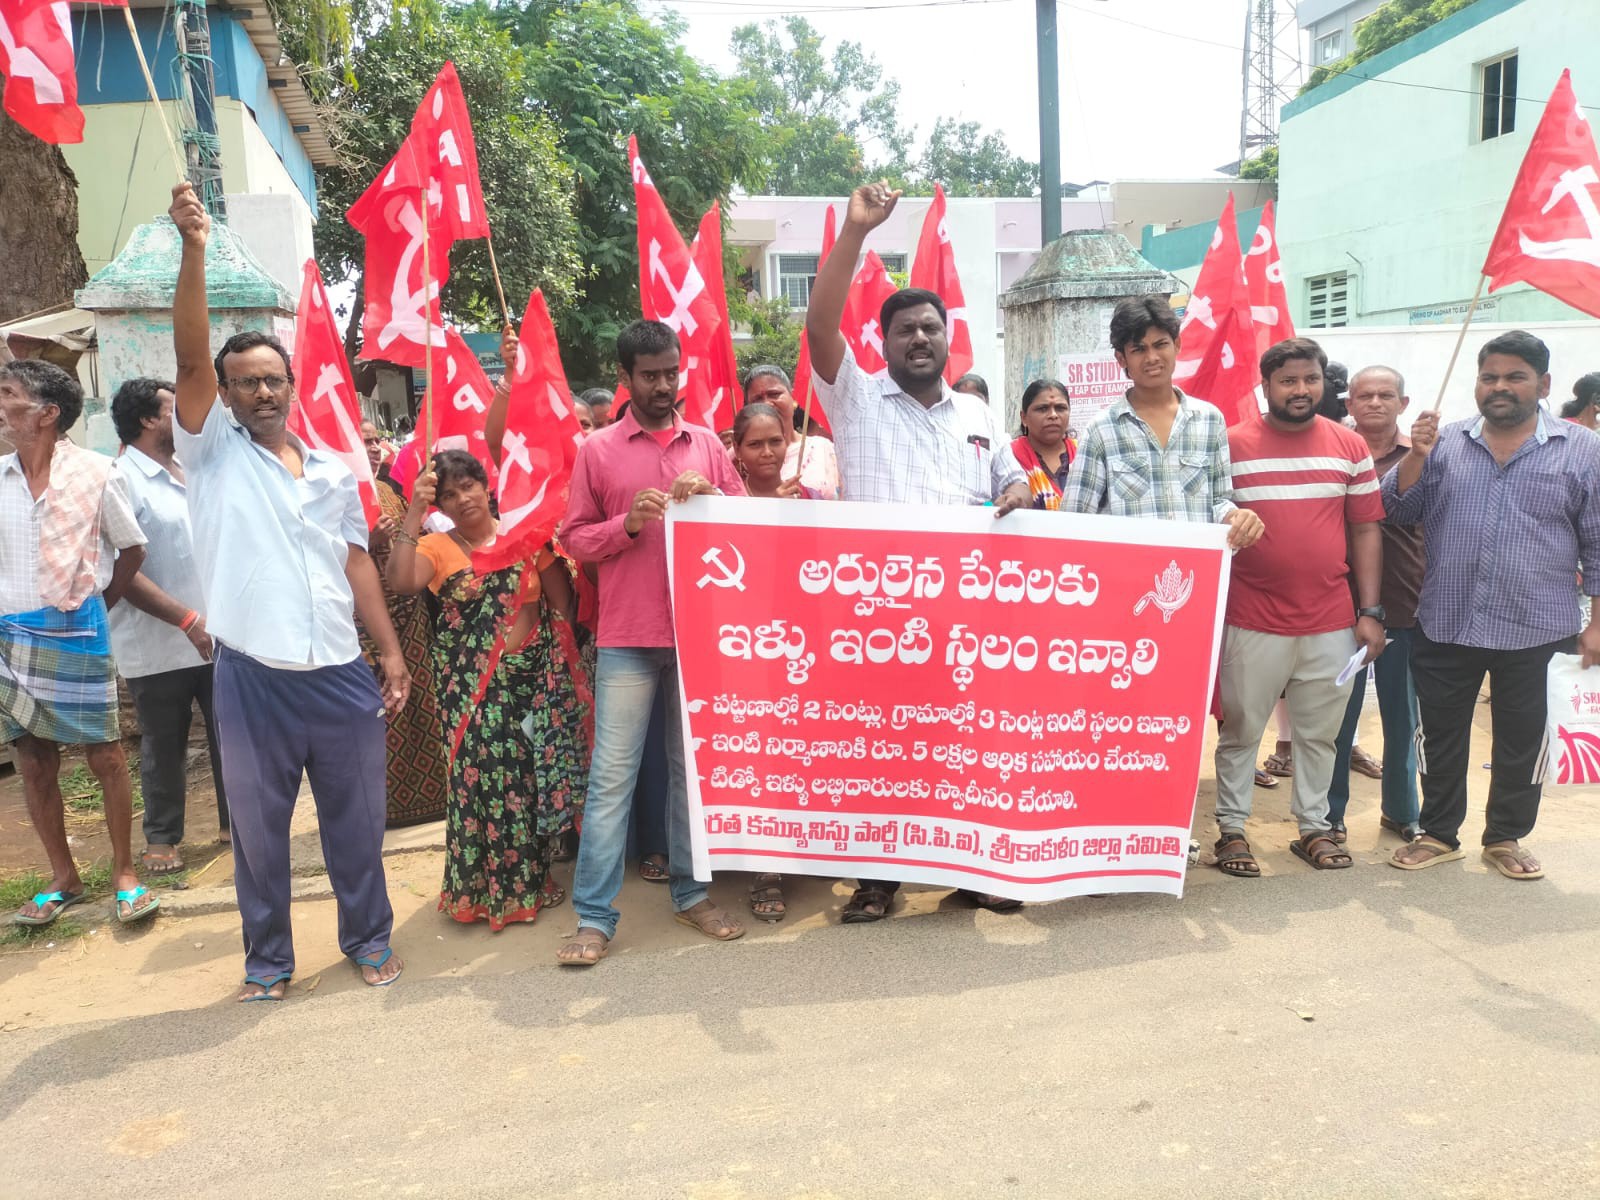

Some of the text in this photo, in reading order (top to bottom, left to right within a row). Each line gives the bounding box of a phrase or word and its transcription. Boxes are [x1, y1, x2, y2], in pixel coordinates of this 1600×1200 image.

[1068, 361, 1121, 383] SR STUDY
[798, 549, 1100, 616] అర్హులైన పేదలకు
[830, 617, 933, 665] ఇంటి
[945, 624, 1039, 691] స్థలం
[1048, 638, 1159, 689] ఇవ్వాలి
[712, 693, 799, 725] పట్టణాల్లో
[803, 700, 821, 720] 2
[891, 700, 976, 733] గ్రామాల్లో
[979, 709, 995, 729] 3
[999, 709, 1044, 740] సెంట్ల
[1046, 708, 1087, 733] ఇంటి
[1089, 711, 1133, 744] స్థలం
[1136, 715, 1191, 743] ఇవ్వాలి
[711, 731, 761, 755] ఇంటి
[765, 736, 867, 767] నిర్మాణానికి
[871, 739, 908, 761] రూ.
[912, 741, 928, 761] 5
[932, 743, 979, 775] లక్షల
[1031, 749, 1100, 773] సహాయం
[1103, 746, 1170, 772] చేయాలి.
[1017, 785, 1078, 812] చేయాలి.
[704, 813, 742, 836] రత
[854, 820, 899, 854] పార్టీ
[989, 833, 1080, 865] శ్రీకాకుళం
[1082, 837, 1122, 862] జిల్లా
